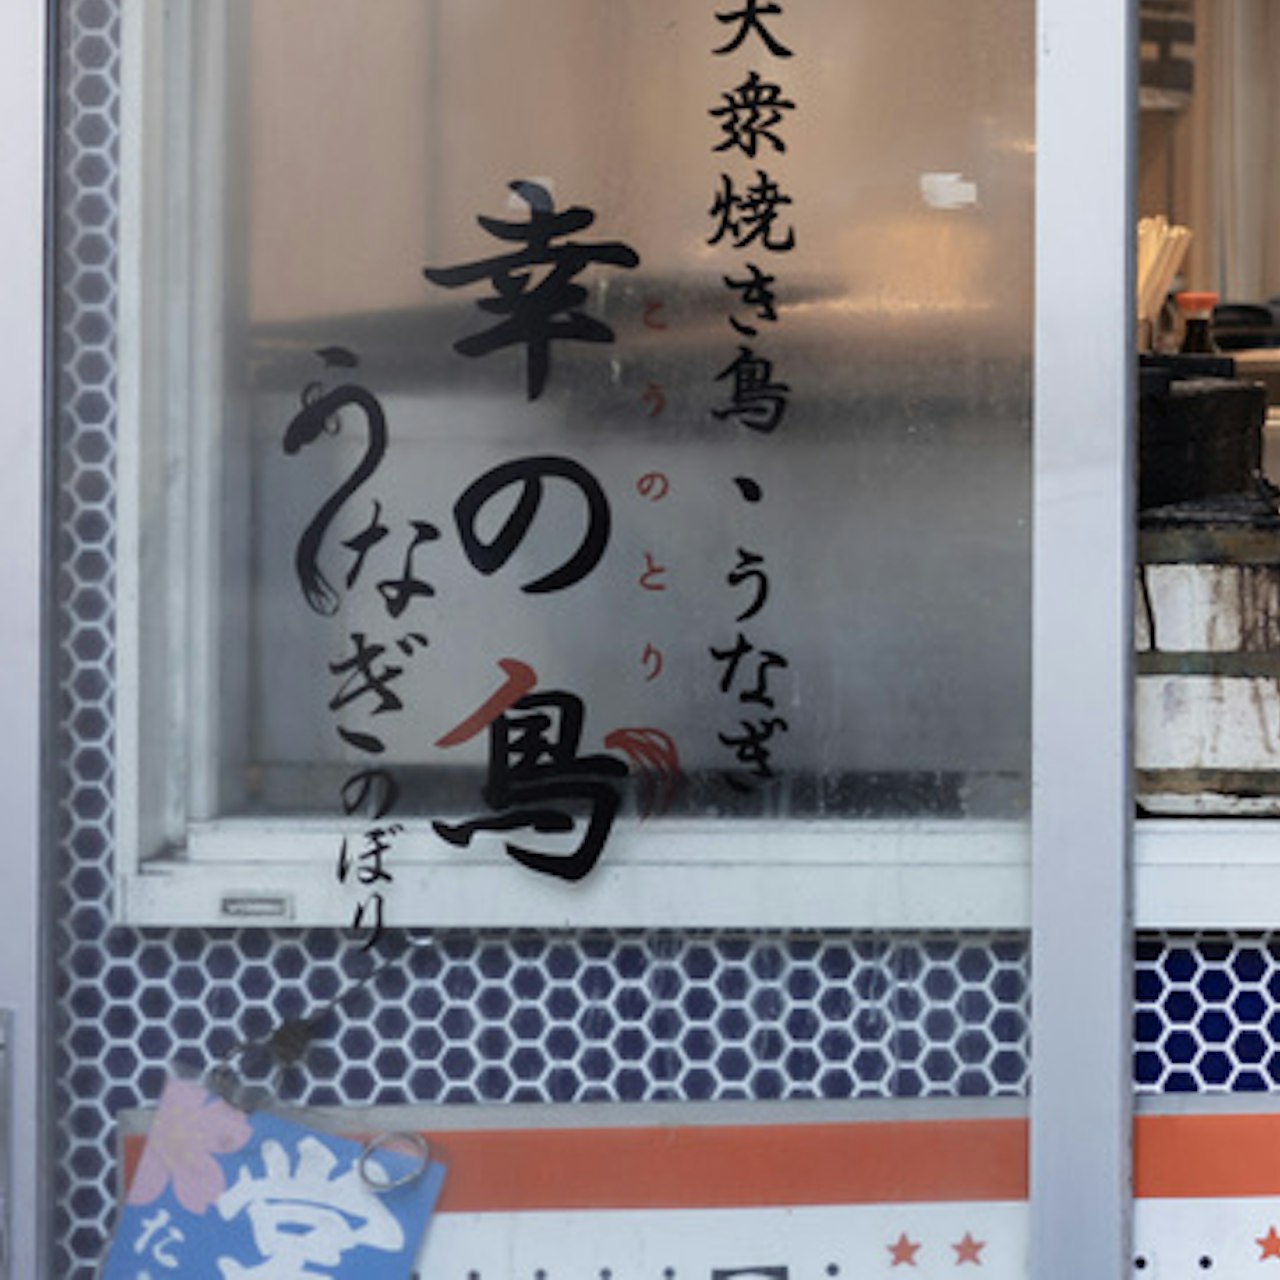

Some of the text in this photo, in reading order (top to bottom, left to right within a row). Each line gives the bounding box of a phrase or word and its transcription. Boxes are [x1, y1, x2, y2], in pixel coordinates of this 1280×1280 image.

[636, 300, 669, 682] こうのとり
